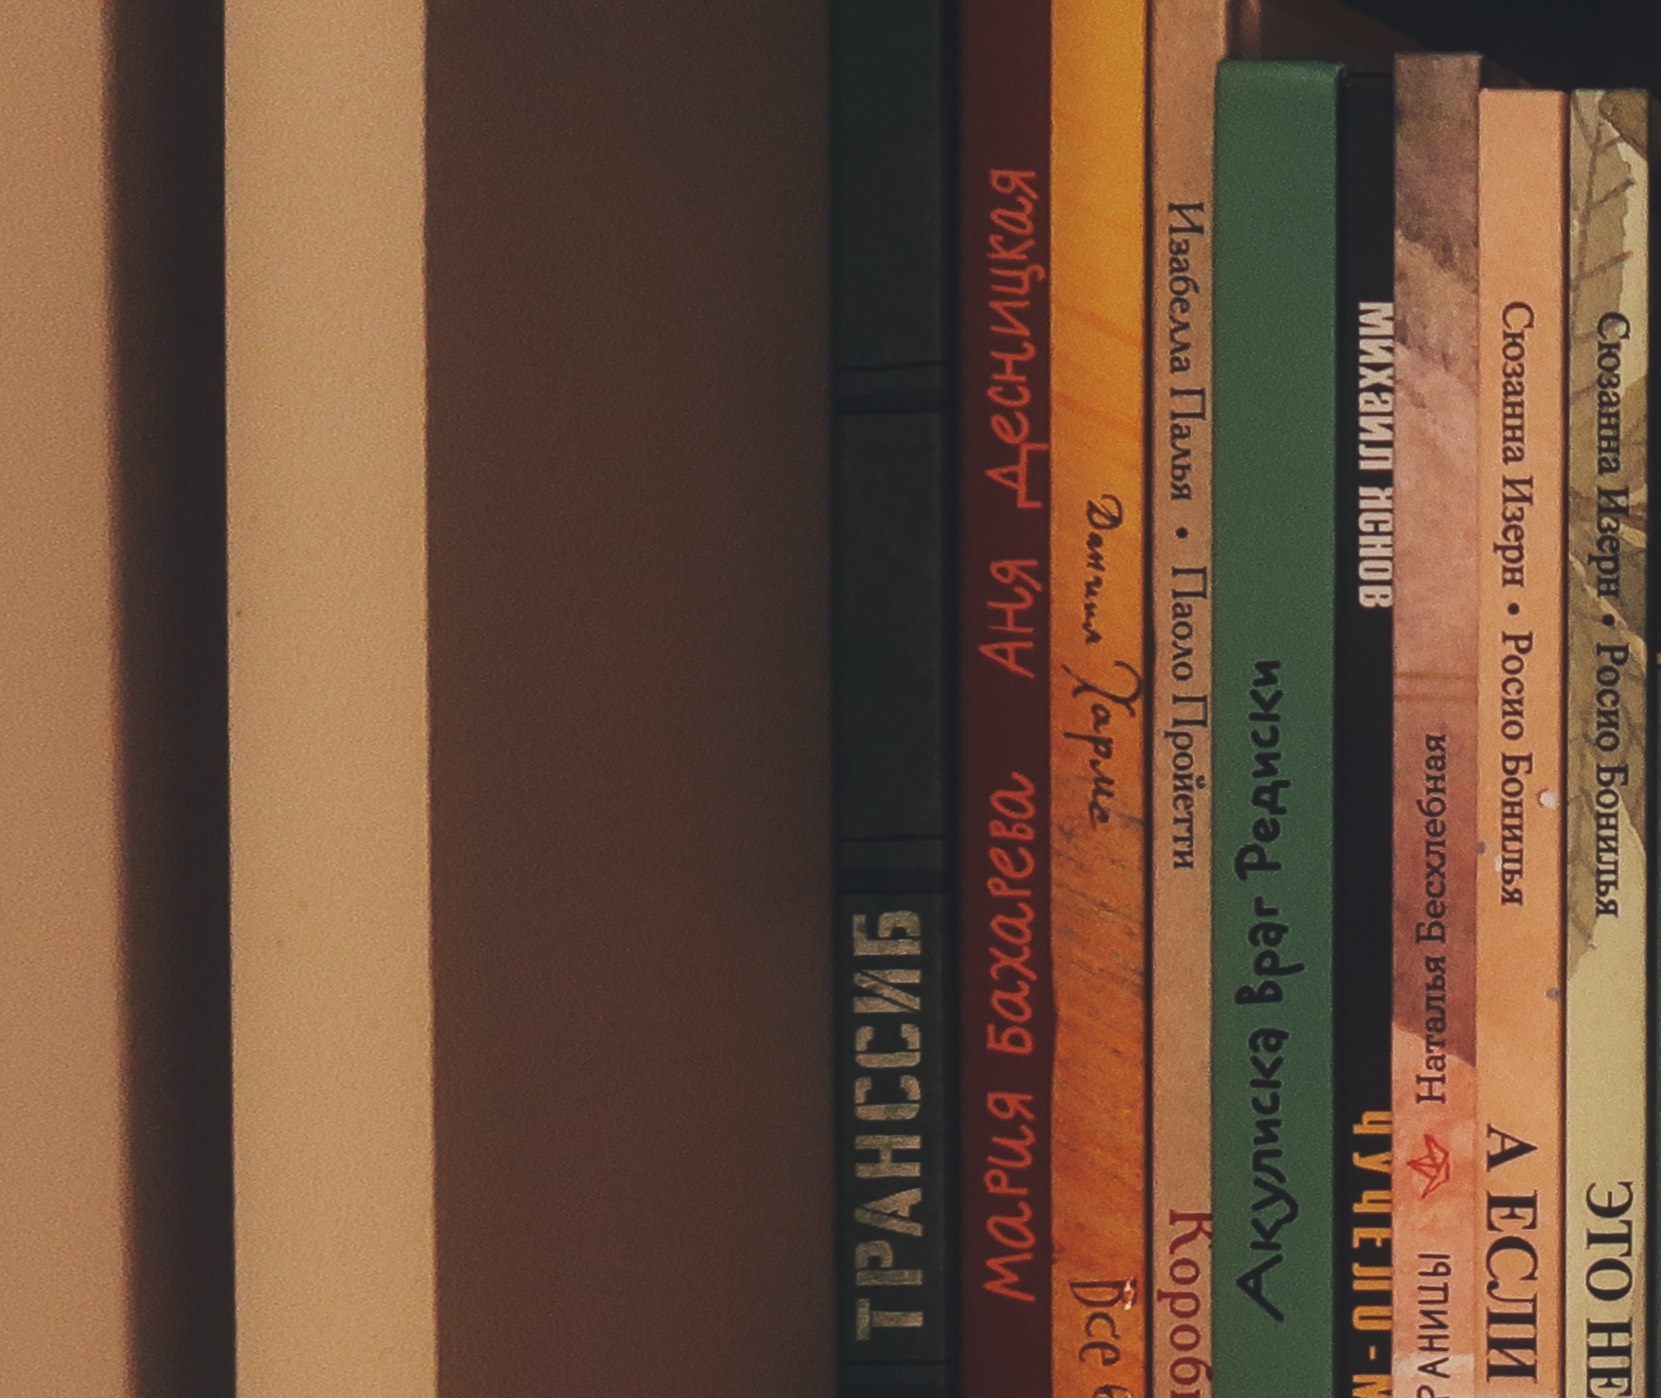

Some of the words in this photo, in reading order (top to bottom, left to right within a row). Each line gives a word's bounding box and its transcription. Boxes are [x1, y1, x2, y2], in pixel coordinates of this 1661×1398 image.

[1168, 202, 1204, 373] Изабелла
[1170, 388, 1206, 500] Палья
[1502, 301, 1534, 465] Сюзанна
[1493, 476, 1533, 587] Изерн
[1172, 567, 1208, 681] Паоло
[1501, 632, 1533, 741] Росио
[1164, 695, 1208, 868] Пройетти
[1235, 661, 1290, 881] Редиски
[1415, 735, 1447, 944] Бесхлебная
[1496, 753, 1532, 905] Бонилья
[1235, 897, 1304, 1004] Враг
[1417, 956, 1446, 1101] Наталья
[853, 911, 923, 1338] ТРАНССИБ
[1236, 1029, 1298, 1322] Акулиска
[1487, 1124, 1537, 1171] А
[1486, 1193, 1537, 1380] ЕСЛИ
[1586, 1182, 1633, 1301] ЭТО
[1587, 1318, 1632, 1398] НЕ
